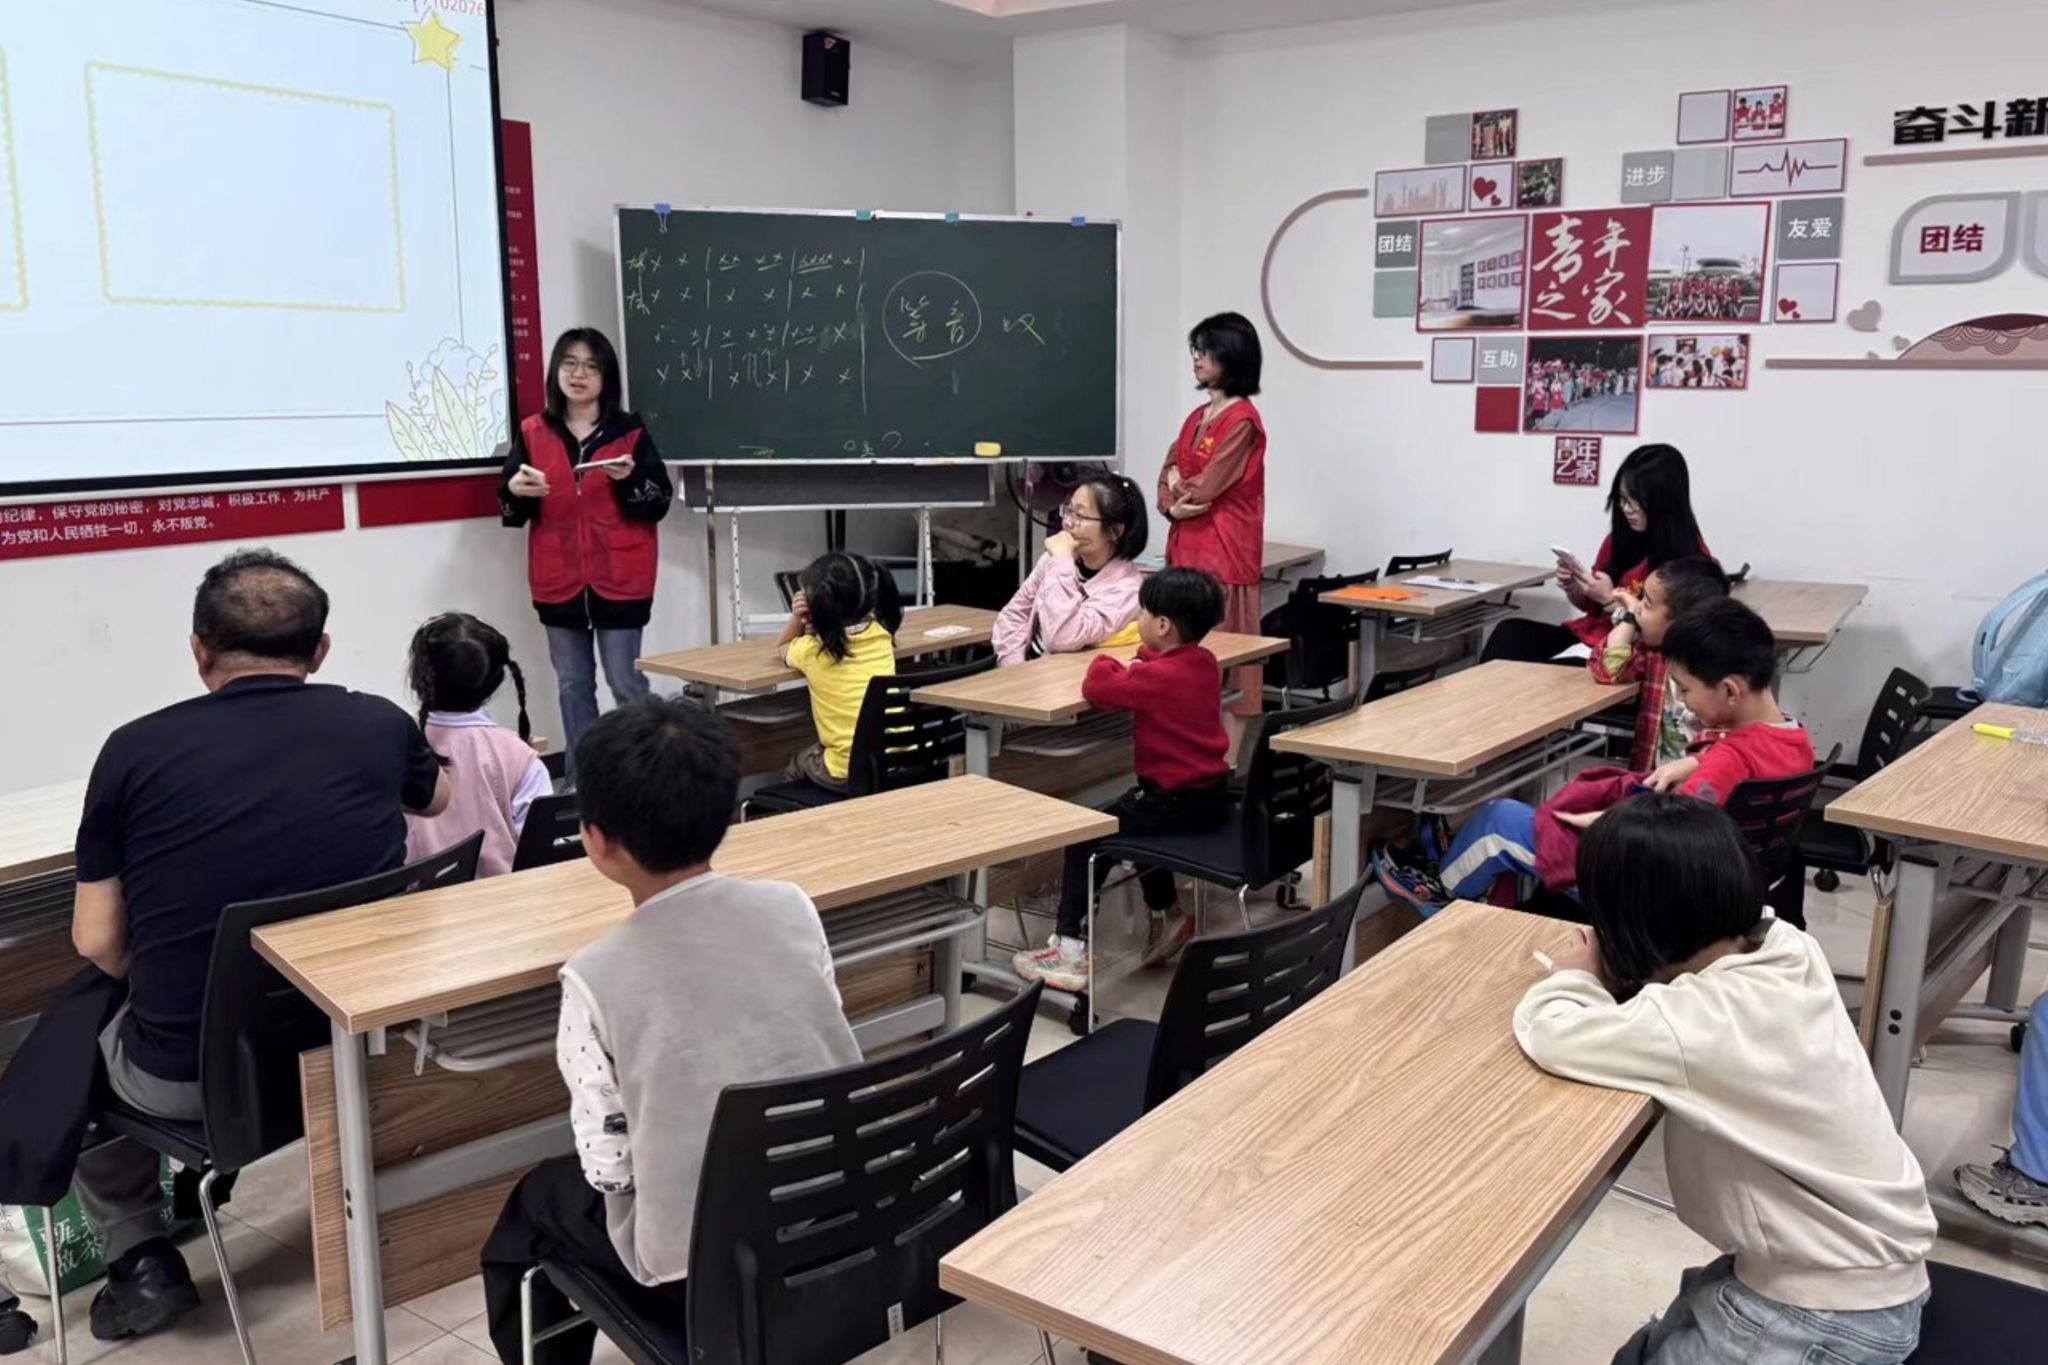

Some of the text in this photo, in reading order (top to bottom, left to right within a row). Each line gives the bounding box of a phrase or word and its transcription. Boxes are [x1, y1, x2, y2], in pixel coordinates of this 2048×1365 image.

[1893, 96, 2048, 145] 奋斗新
[1624, 165, 1667, 187] 进步
[1787, 217, 1833, 239] 友爱
[1919, 223, 1985, 254] 团结
[1378, 234, 1413, 253] 团结
[1480, 349, 1518, 368] 互助
[0, 487, 330, 523] 纪律，保守党的秘密，对党忠诚，积极工作，为共产
